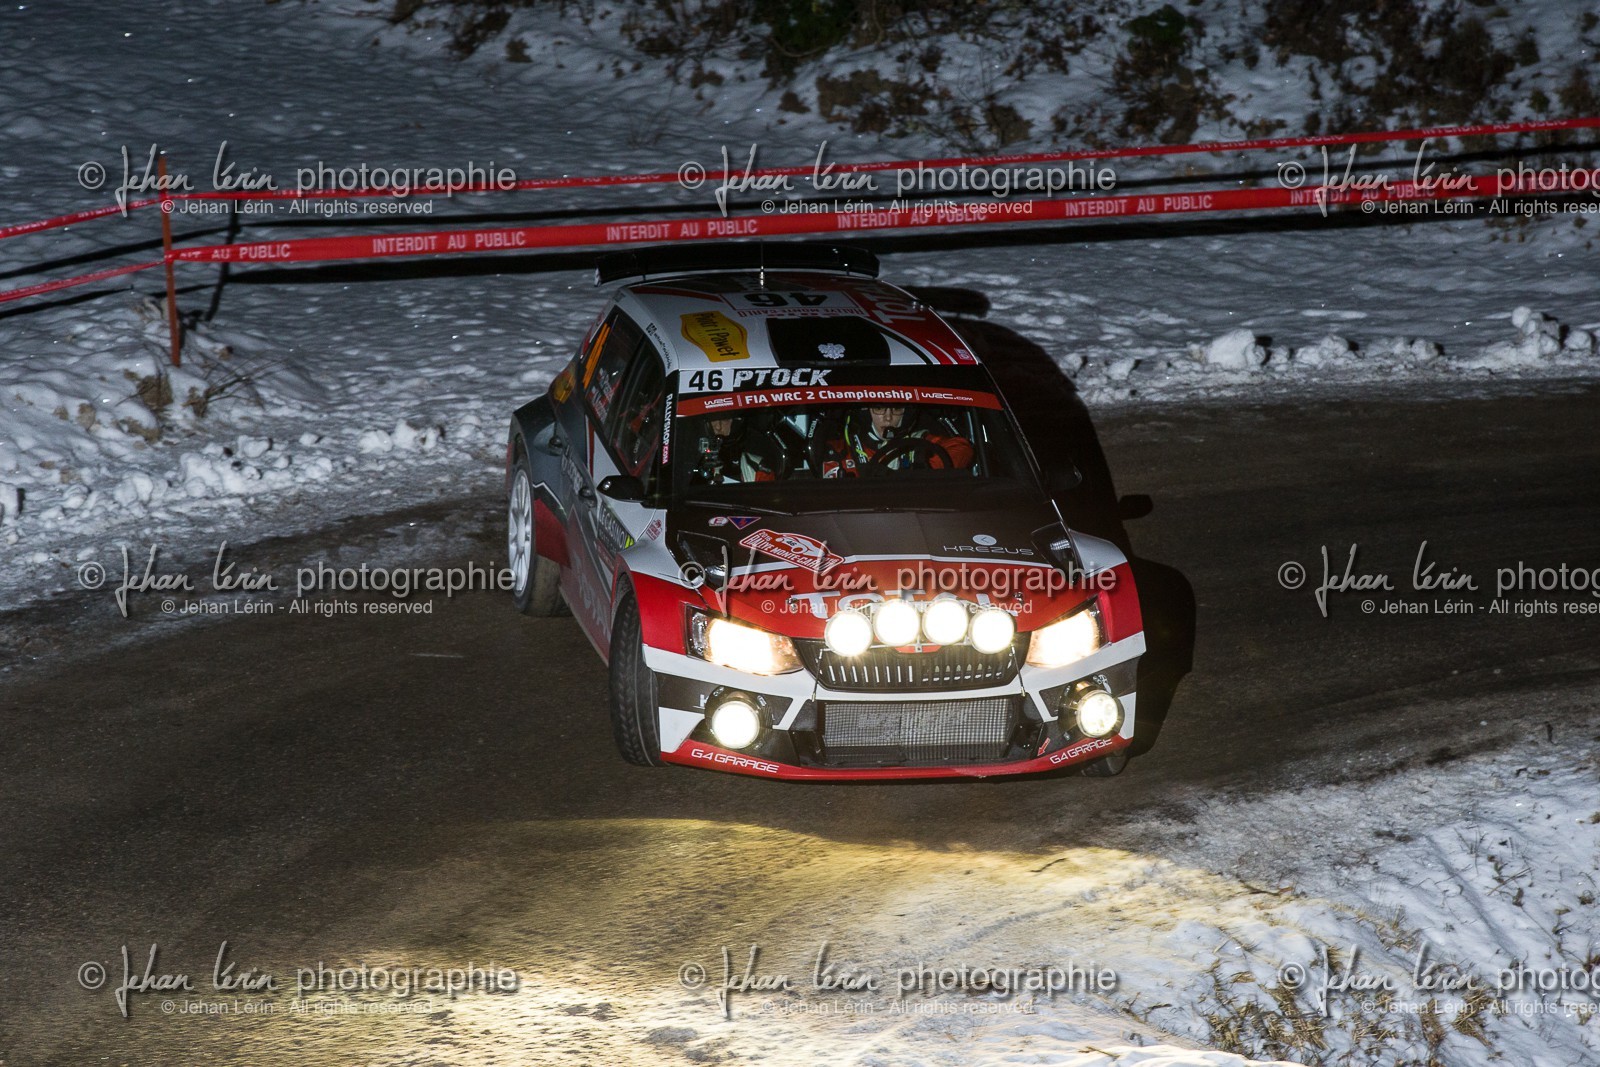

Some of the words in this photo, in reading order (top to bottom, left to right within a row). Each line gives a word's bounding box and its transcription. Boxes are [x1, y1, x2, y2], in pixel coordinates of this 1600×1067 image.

[1361, 187, 1378, 200] AU
[1387, 183, 1435, 199] PUBLIC
[1065, 199, 1127, 217] INTERDIT
[1137, 198, 1155, 213] AU
[1164, 194, 1212, 211] PUBLIC
[837, 212, 899, 229] INTERDIT
[910, 210, 928, 225] AU
[937, 206, 986, 223] PUBLIC
[606, 224, 670, 241] INTERDIT
[680, 222, 699, 237] AU
[707, 219, 758, 236] PUBLIC
[211, 249, 229, 259] AU
[239, 244, 290, 259] PUBLIC
[372, 236, 438, 253] INTERDIT
[448, 234, 466, 249] AU
[475, 231, 526, 248] PUBLIC
[744, 292, 828, 307] 46
[689, 370, 723, 391] 46
[733, 368, 832, 388] PTOCK
[745, 394, 768, 404] FIA
[771, 392, 802, 401] WRC
[806, 391, 815, 400] 2
[818, 389, 912, 400] Championship
[662, 393, 673, 465] RALLYSHOP.COM
[744, 534, 773, 551] RALLYE
[758, 531, 772, 540] 2016
[943, 544, 1034, 556] KREZUS
[690, 748, 713, 760] G4
[714, 753, 779, 772] GARAGE
[1049, 752, 1068, 764] G4
[1067, 738, 1112, 757] GARAGE
